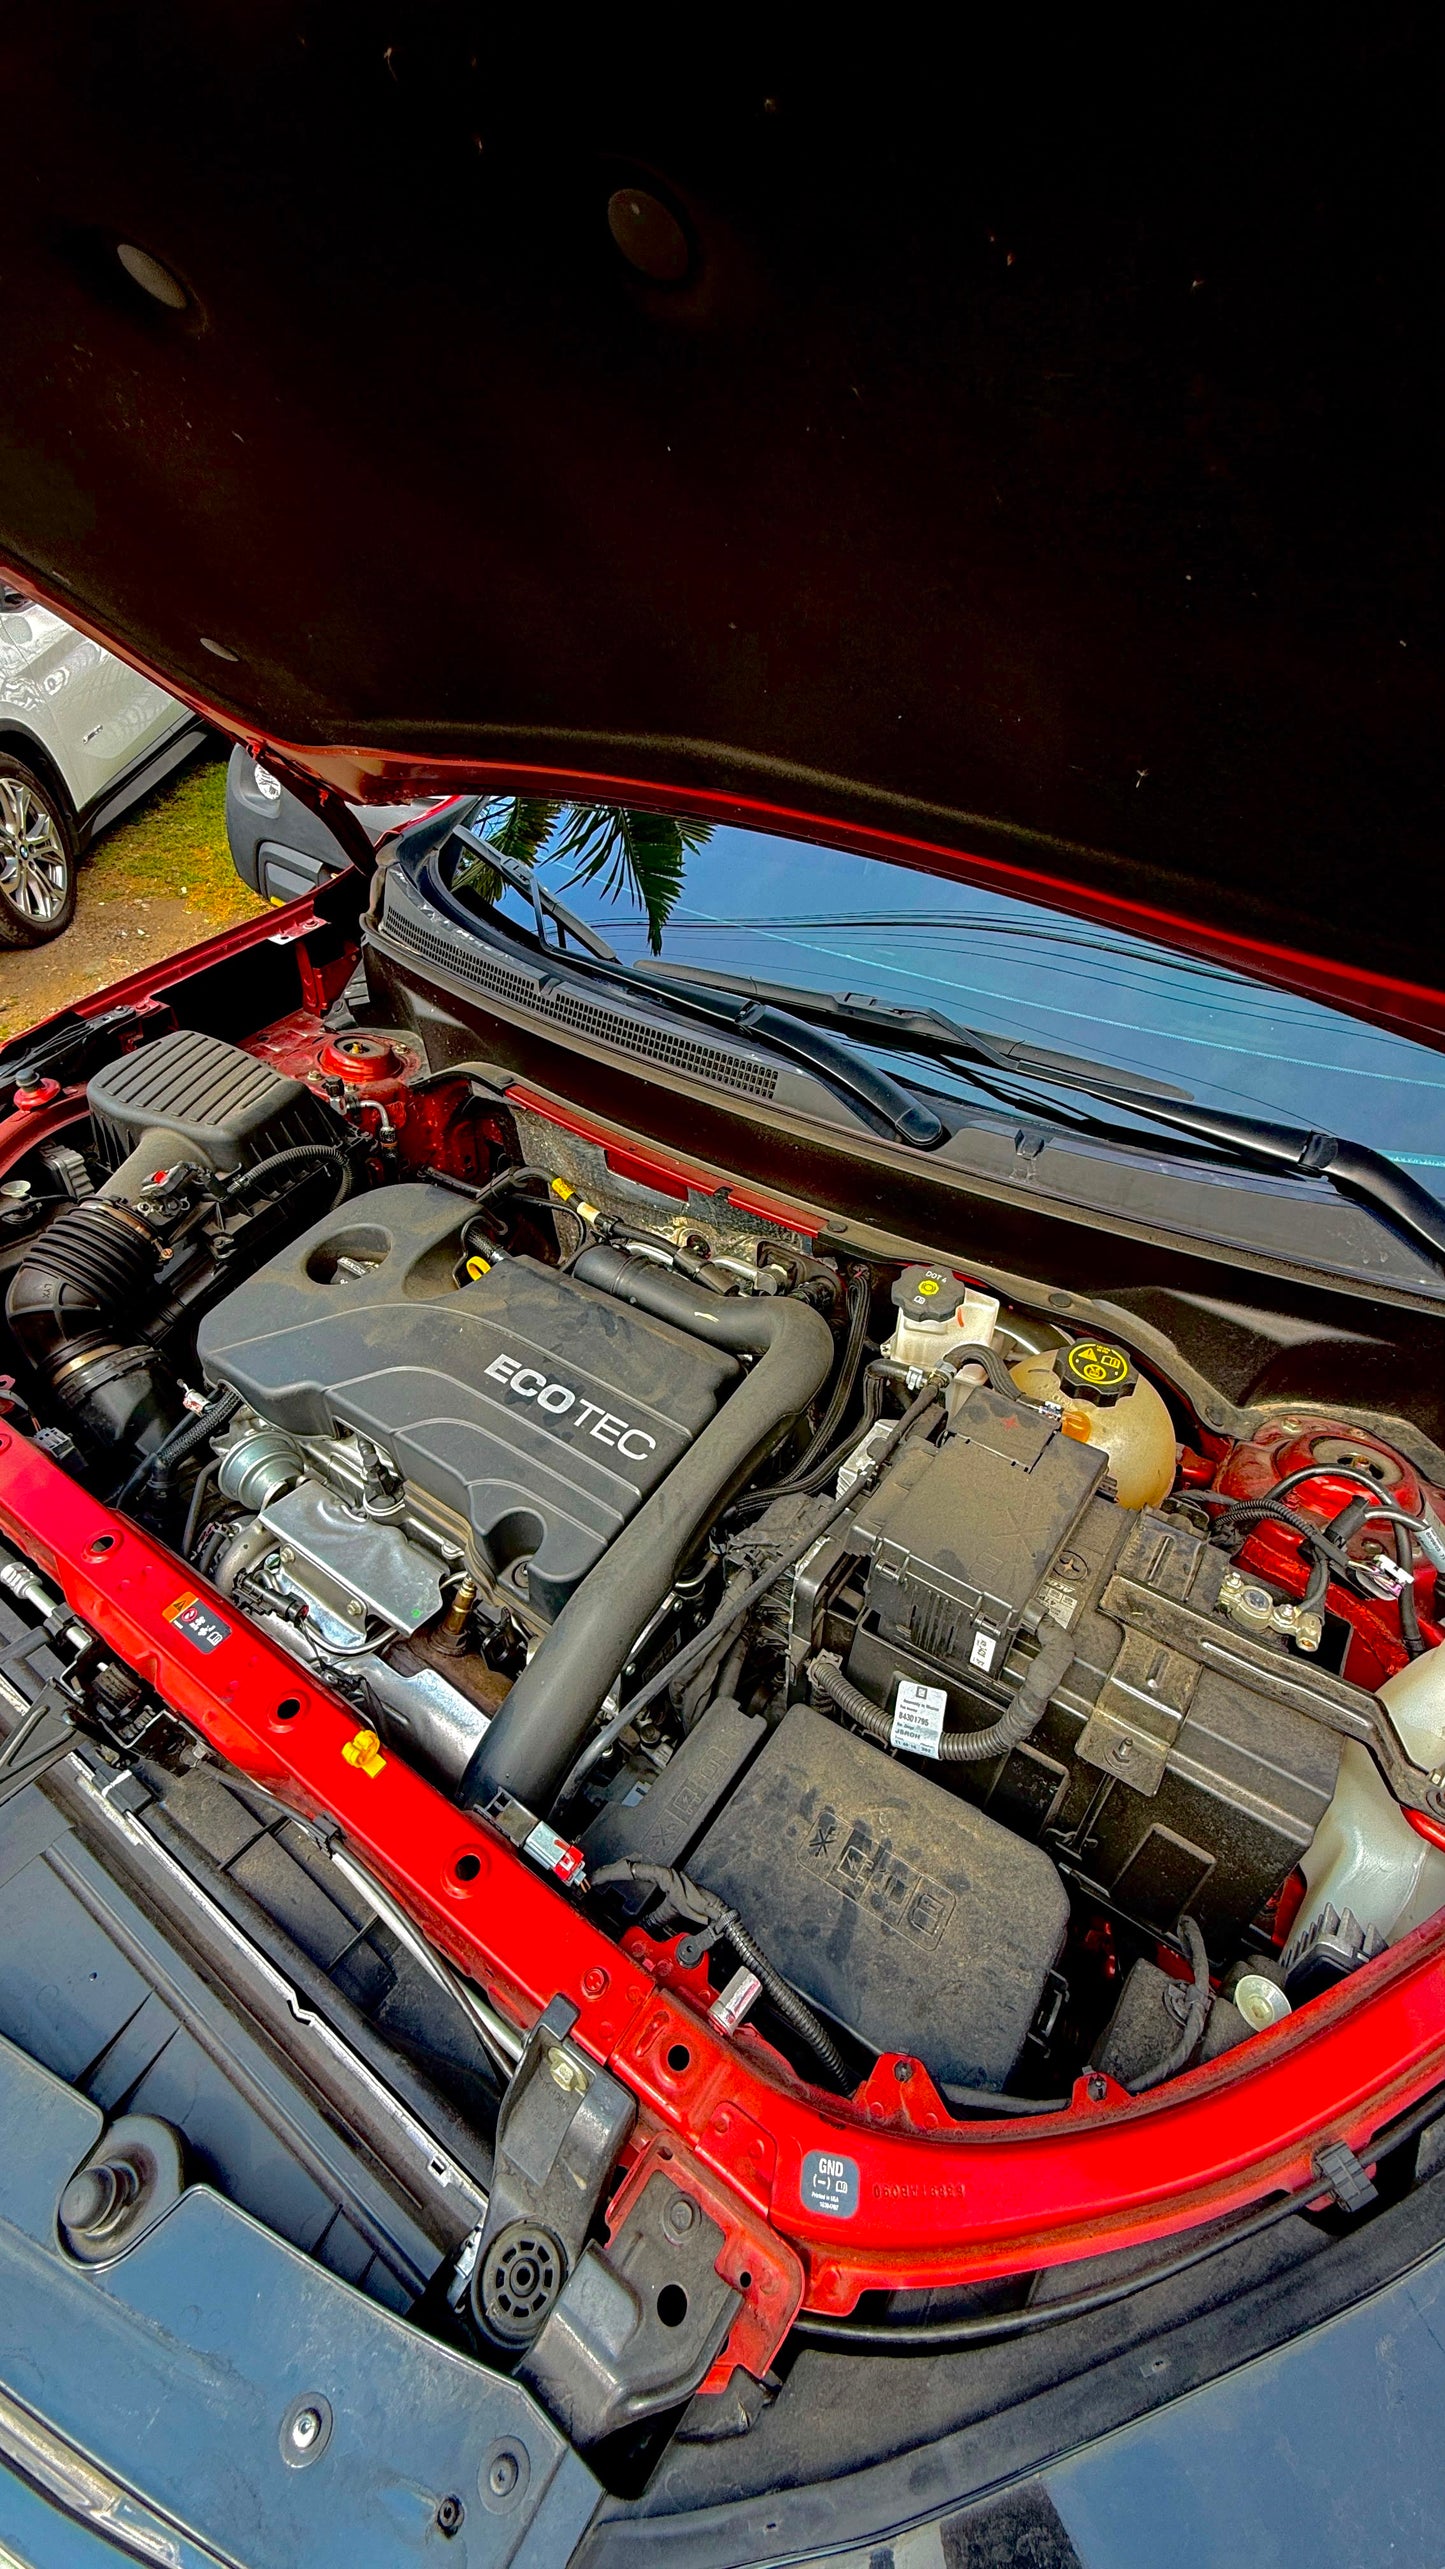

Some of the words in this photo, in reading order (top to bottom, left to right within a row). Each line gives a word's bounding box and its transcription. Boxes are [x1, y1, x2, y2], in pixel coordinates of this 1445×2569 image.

[925, 1270, 942, 1280] DOT
[483, 1353, 657, 1461] ECOTEC
[818, 2157, 844, 2178] GND
